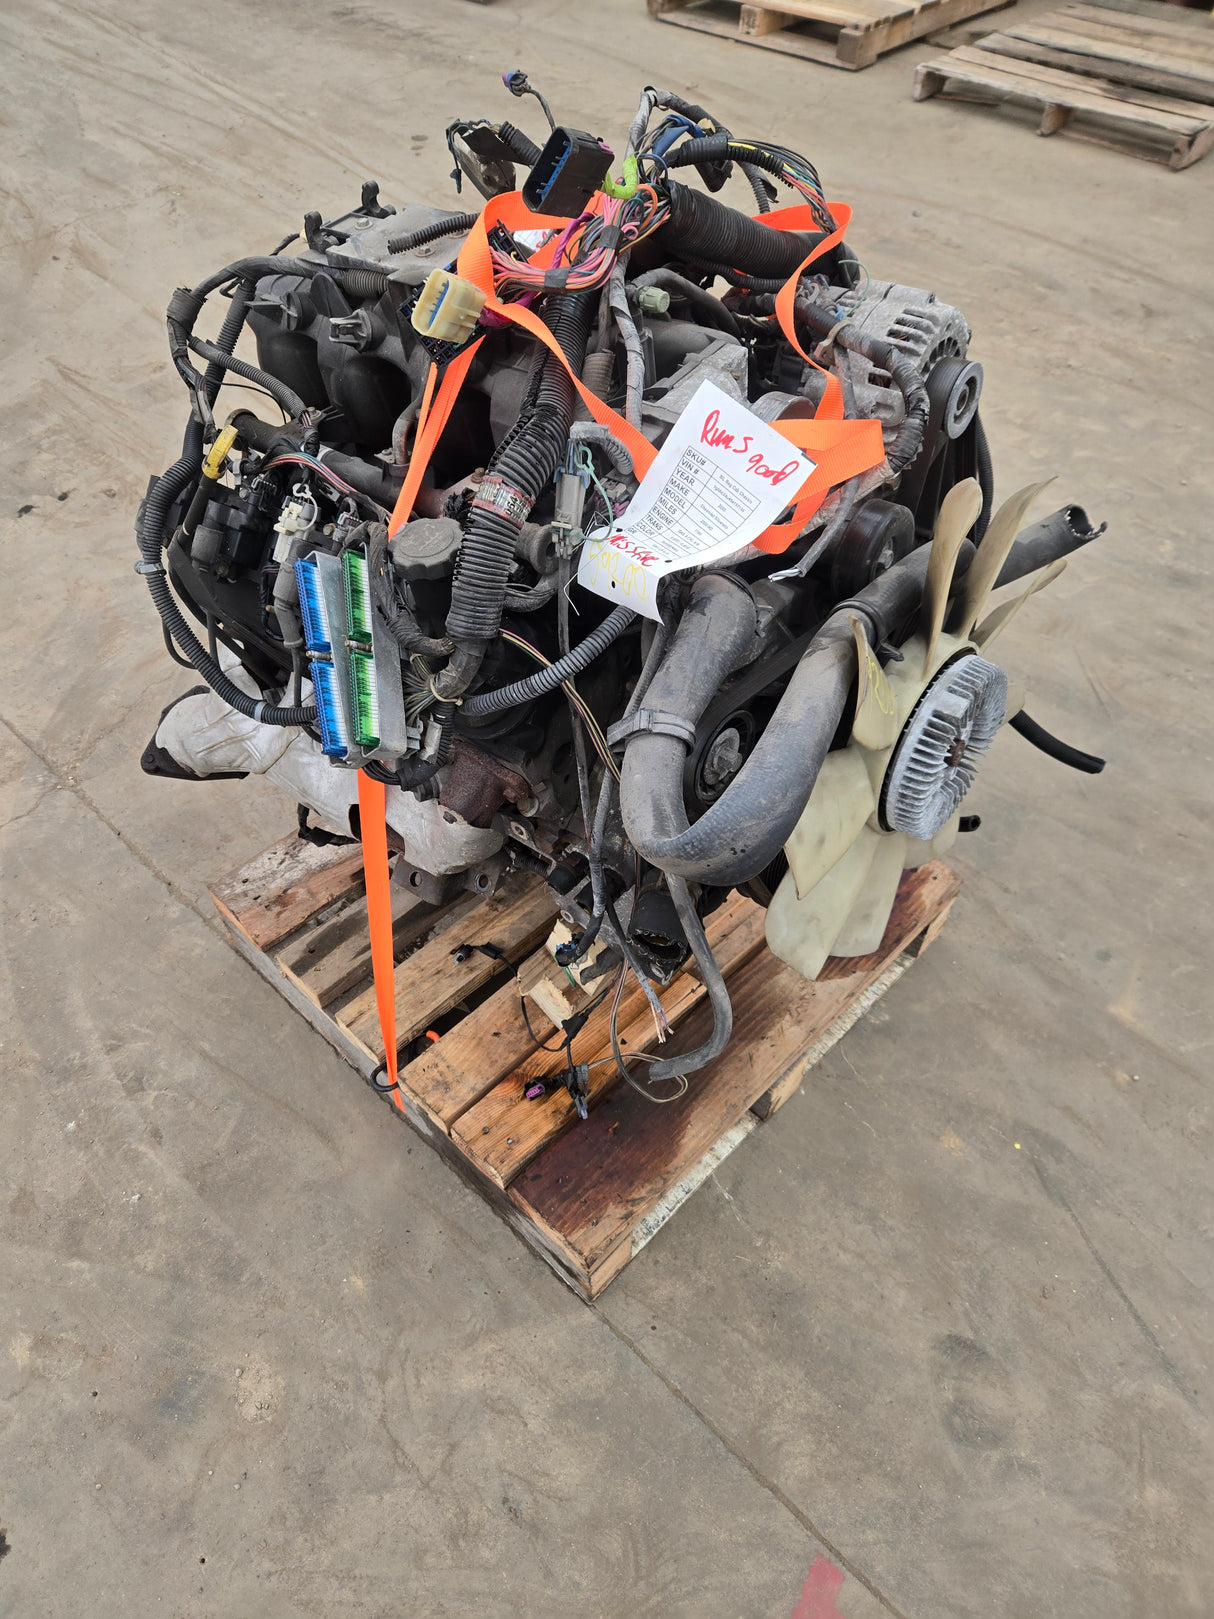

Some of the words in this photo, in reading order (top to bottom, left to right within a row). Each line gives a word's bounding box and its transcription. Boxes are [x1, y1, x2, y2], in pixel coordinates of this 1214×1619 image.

[681, 458, 694, 472] VIN
[686, 449, 707, 466] SKU#
[675, 468, 696, 487] YEAR
[746, 453, 799, 486] good
[669, 478, 690, 497] MAKE
[659, 497, 677, 515] MILES
[663, 487, 687, 509] MODEL
[646, 514, 663, 531] TRANS
[652, 506, 674, 526] ENGINE
[637, 522, 655, 536] COLOR
